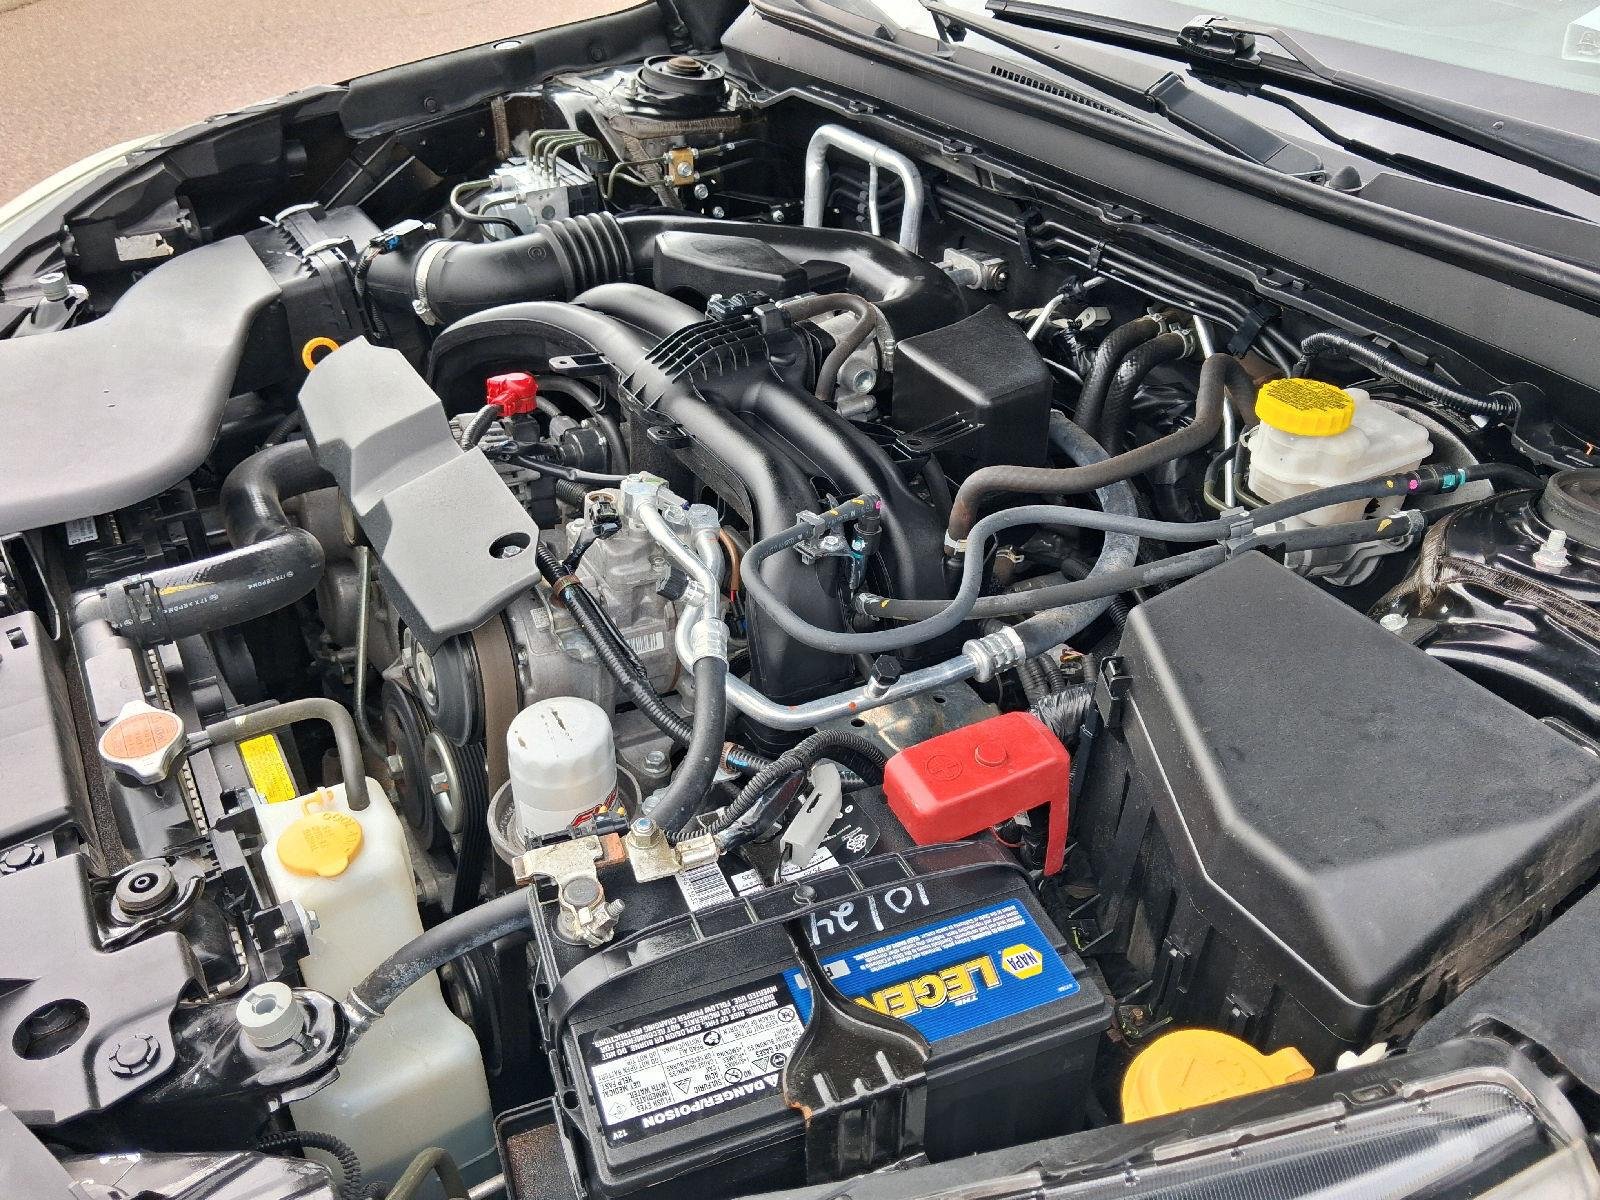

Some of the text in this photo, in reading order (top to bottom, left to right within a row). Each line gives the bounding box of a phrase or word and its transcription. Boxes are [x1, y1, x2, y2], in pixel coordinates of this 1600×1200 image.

[810, 882, 930, 946] 10/24
[1007, 952, 1037, 970] NAPA
[694, 1079, 722, 1093] SULFURIC
[642, 1079, 765, 1128] DANGER/POISON
[612, 1129, 628, 1141] 12V
